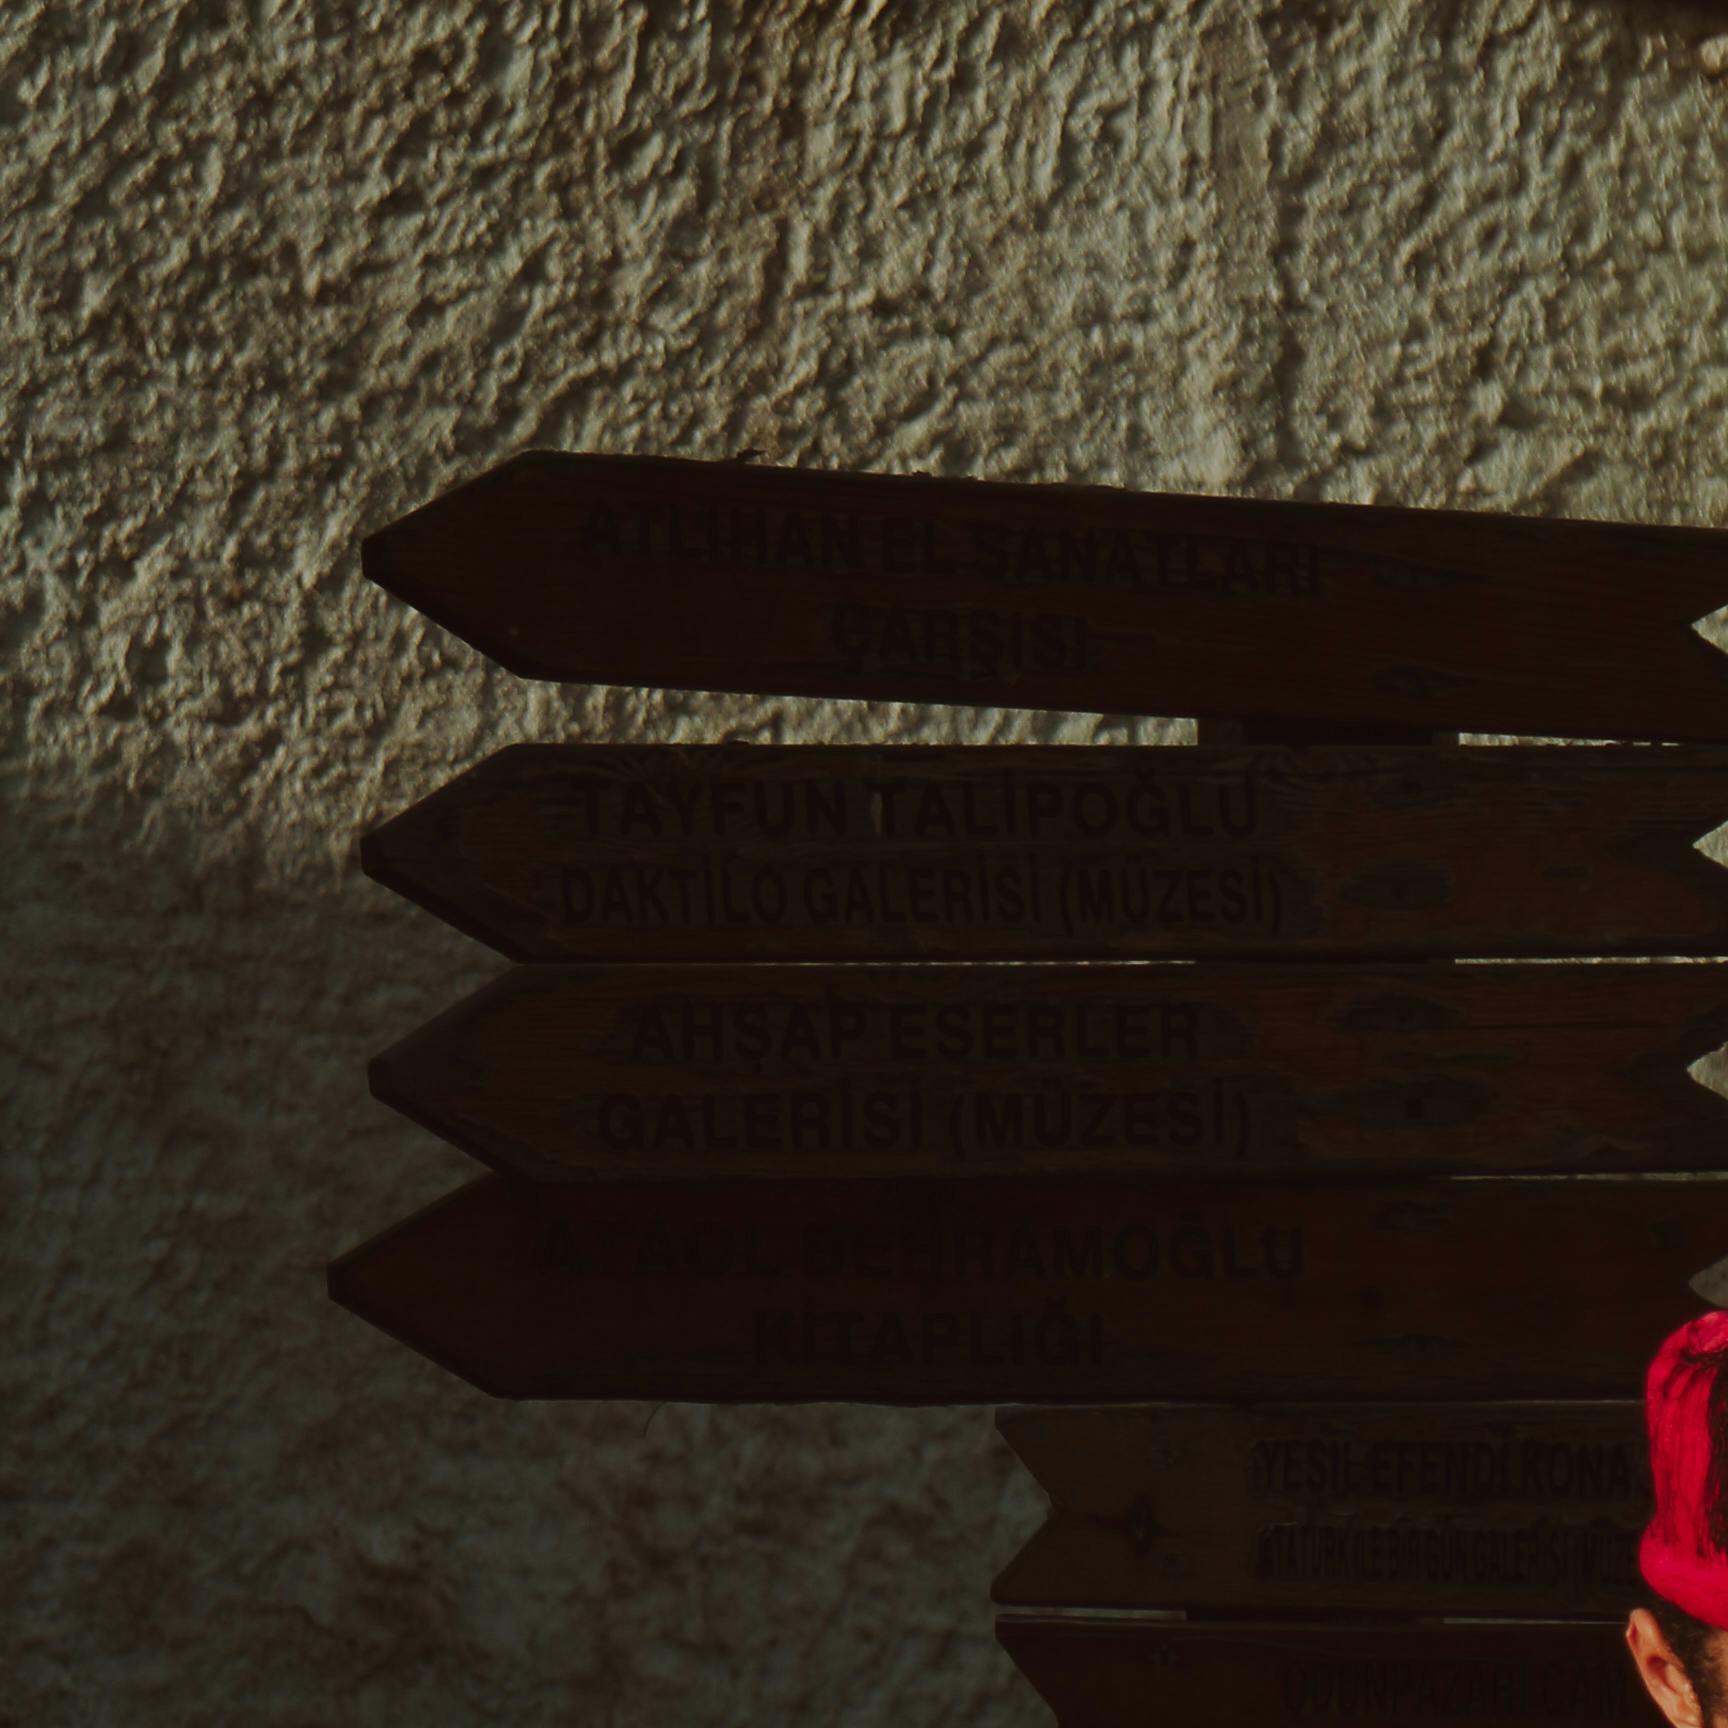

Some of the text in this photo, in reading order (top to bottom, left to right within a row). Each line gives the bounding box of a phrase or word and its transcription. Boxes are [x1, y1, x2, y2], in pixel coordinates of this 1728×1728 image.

[883, 518, 955, 575] EL
[974, 523, 1320, 595] SANATLARI
[572, 767, 1257, 835] TAYFUN TALİPOĞLU
[563, 850, 1281, 936] DAKTİLO GALERİSİ (MÜZESİ)
[632, 1000, 1201, 1072] AHŞAP ESERLER
[598, 1077, 1251, 1161] GALERİSİ (MÜZESİ)
[531, 1218, 782, 1281] ATAOL
[1522, 1438, 1640, 1499] KONA
